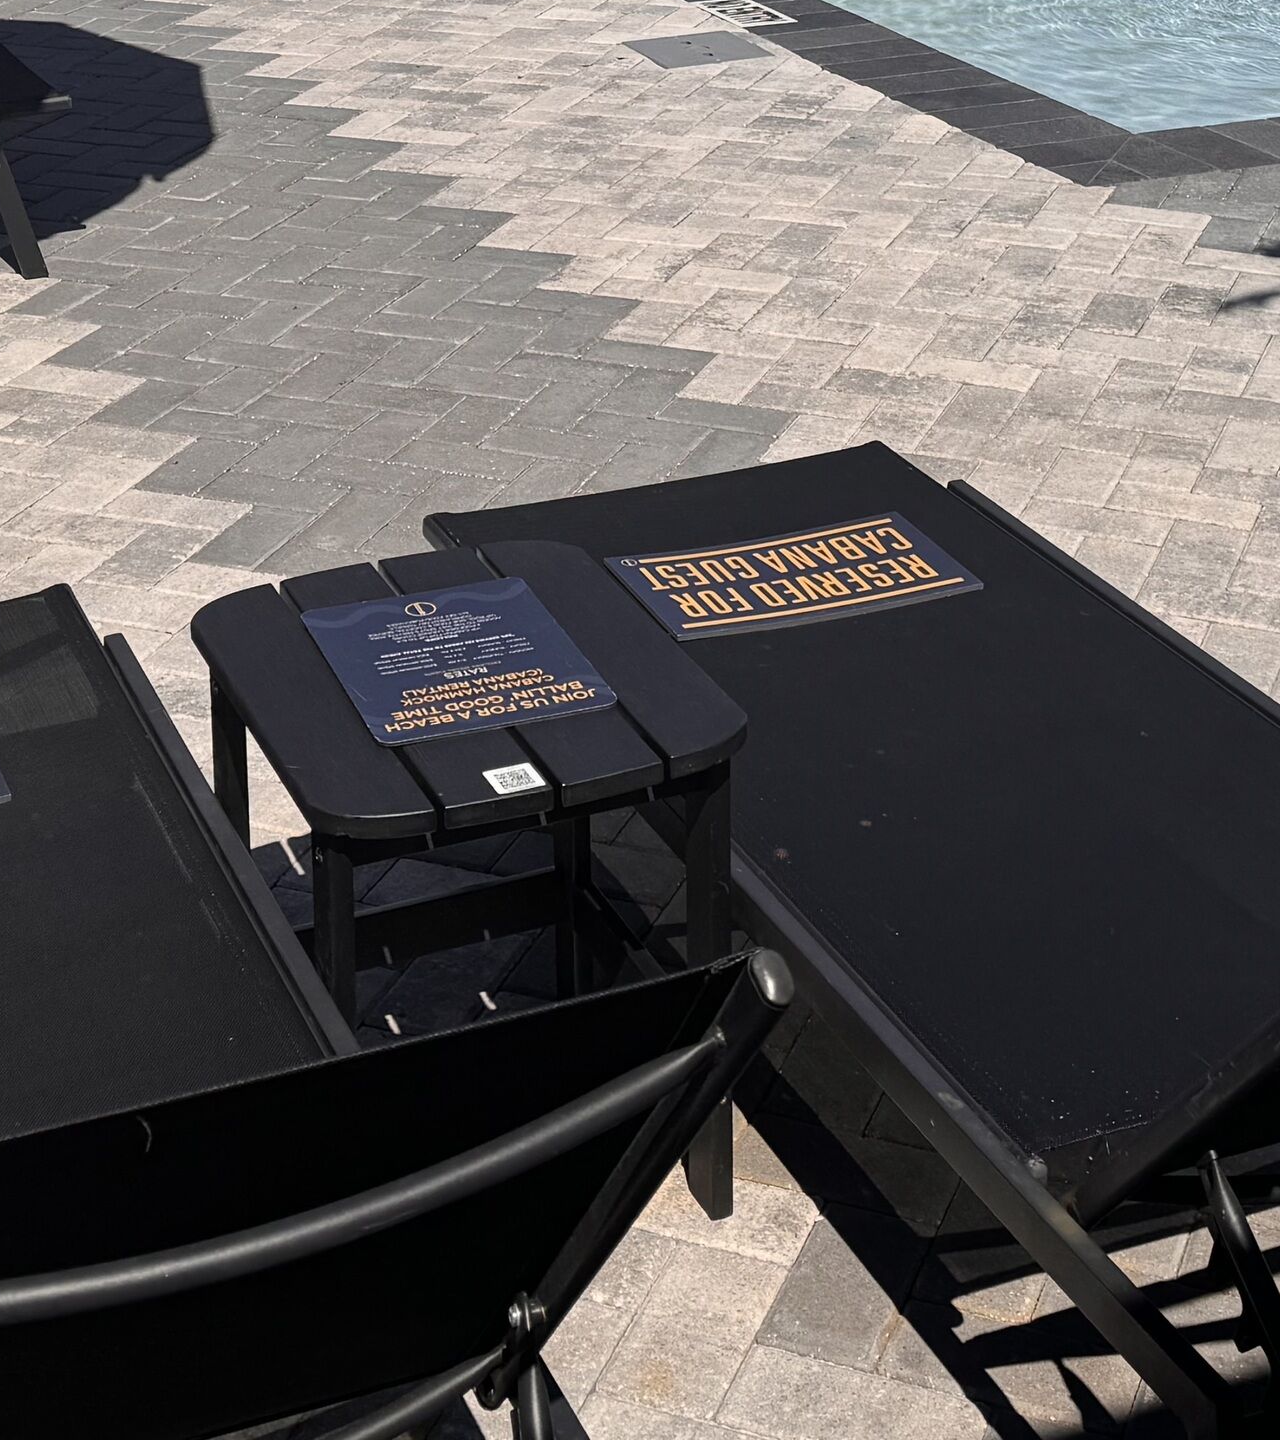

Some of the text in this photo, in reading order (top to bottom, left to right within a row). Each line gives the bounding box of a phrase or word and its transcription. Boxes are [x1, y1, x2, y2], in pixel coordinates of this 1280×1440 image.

[639, 525, 915, 592] CABANA GUEST
[669, 553, 939, 619] RESERVED FOR
[400, 673, 554, 706] CABANA HAMMOCK
[402, 679, 470, 697] RENTAL)
[443, 666, 488, 679] RATES
[471, 667, 543, 685] (CABANA
[384, 687, 596, 733] JOIN US FOR A BEACH
[392, 680, 583, 720] BALLIN' GOOD TIME
